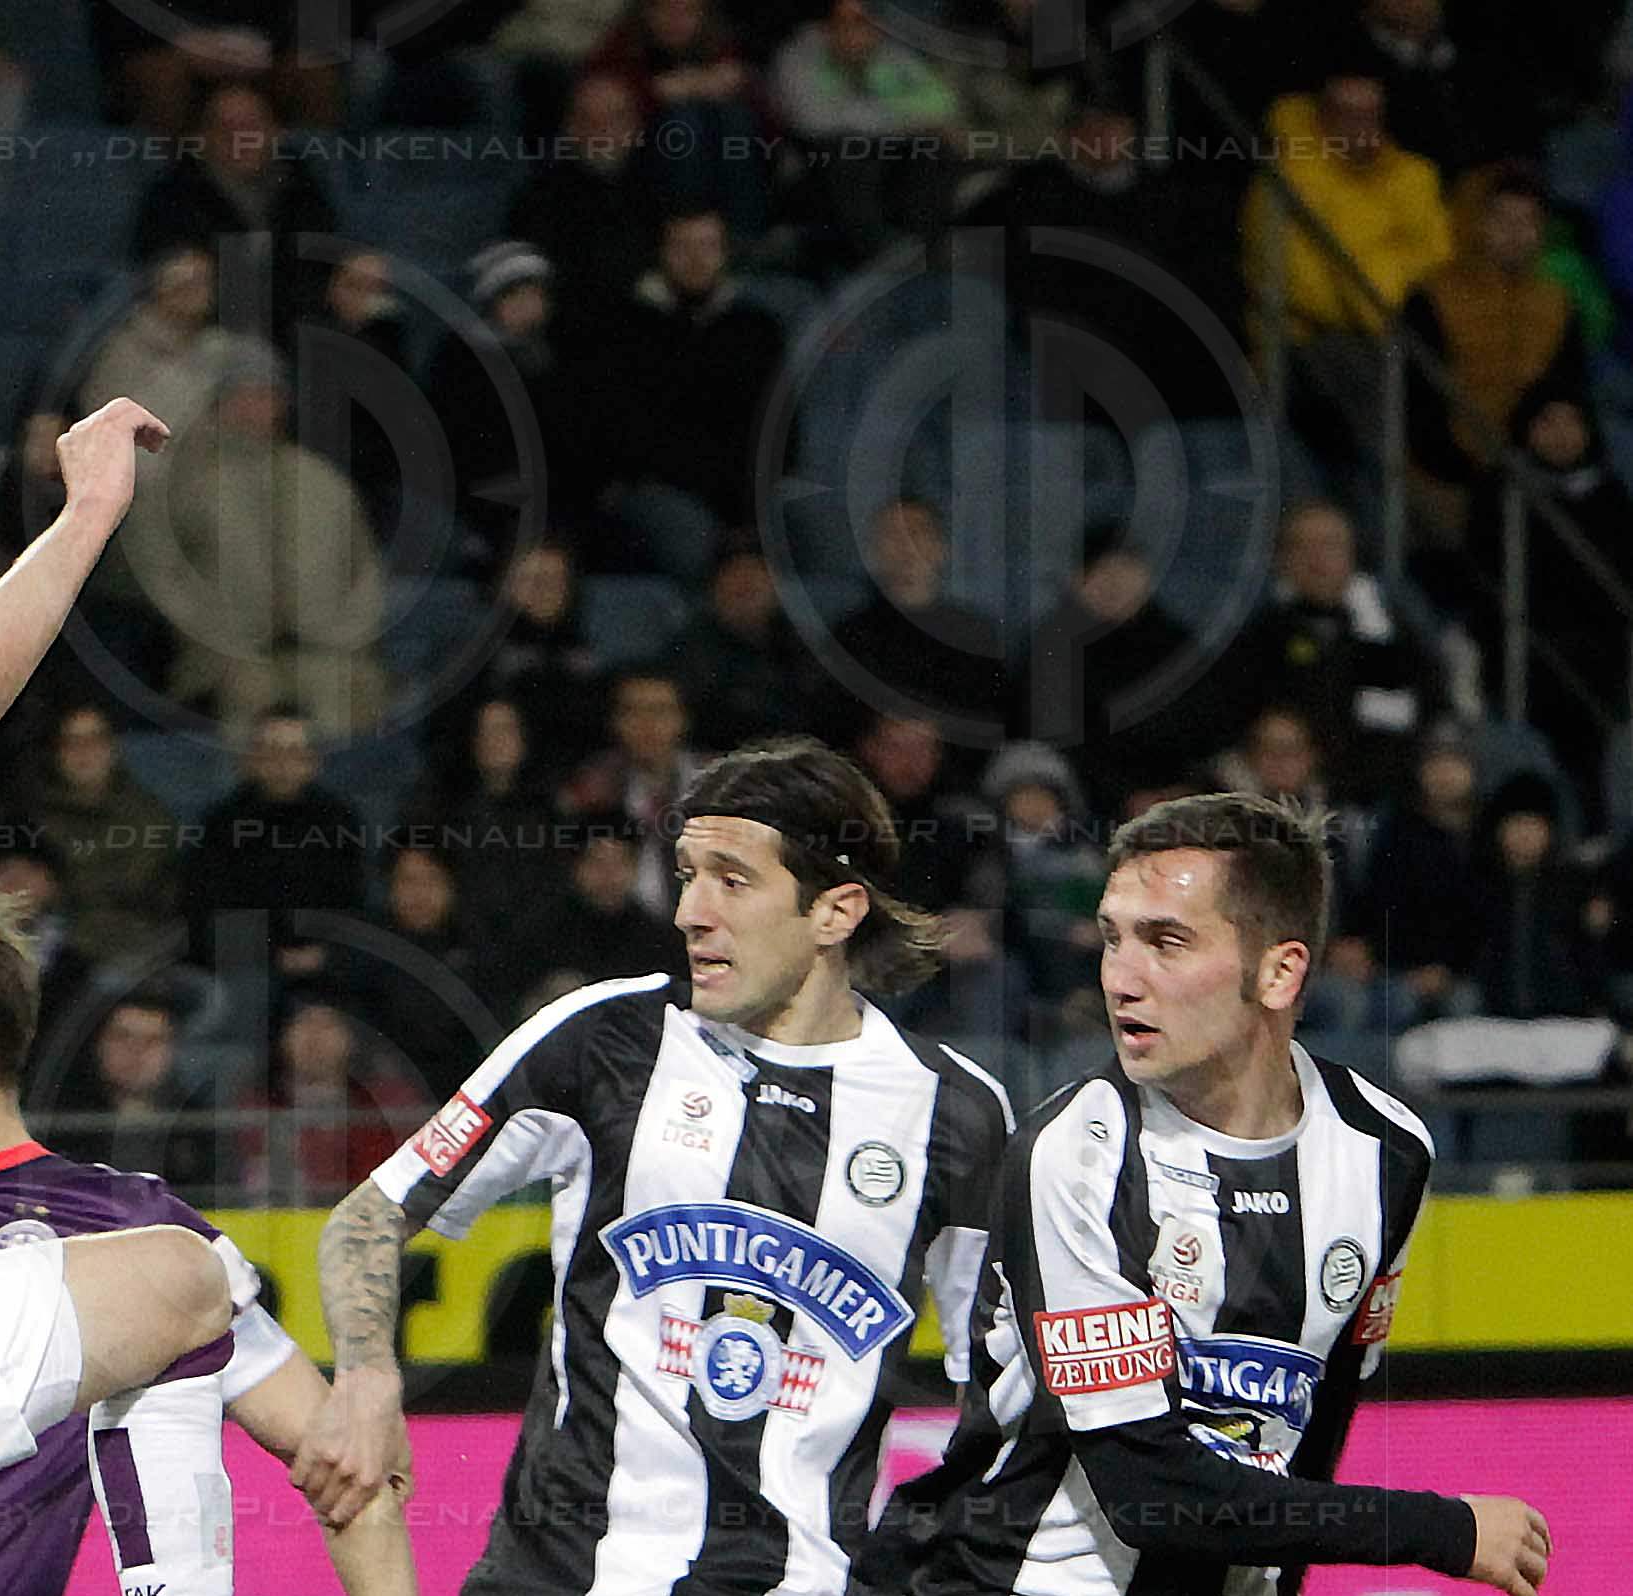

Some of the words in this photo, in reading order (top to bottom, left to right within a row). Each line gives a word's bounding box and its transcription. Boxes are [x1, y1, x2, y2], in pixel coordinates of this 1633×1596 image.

[1232, 1191, 1290, 1214] JAKO
[621, 1222, 886, 1341] PUNTIGAMER
[1040, 1303, 1171, 1355] KLEINE
[1047, 1343, 1174, 1389] ZEITUNG
